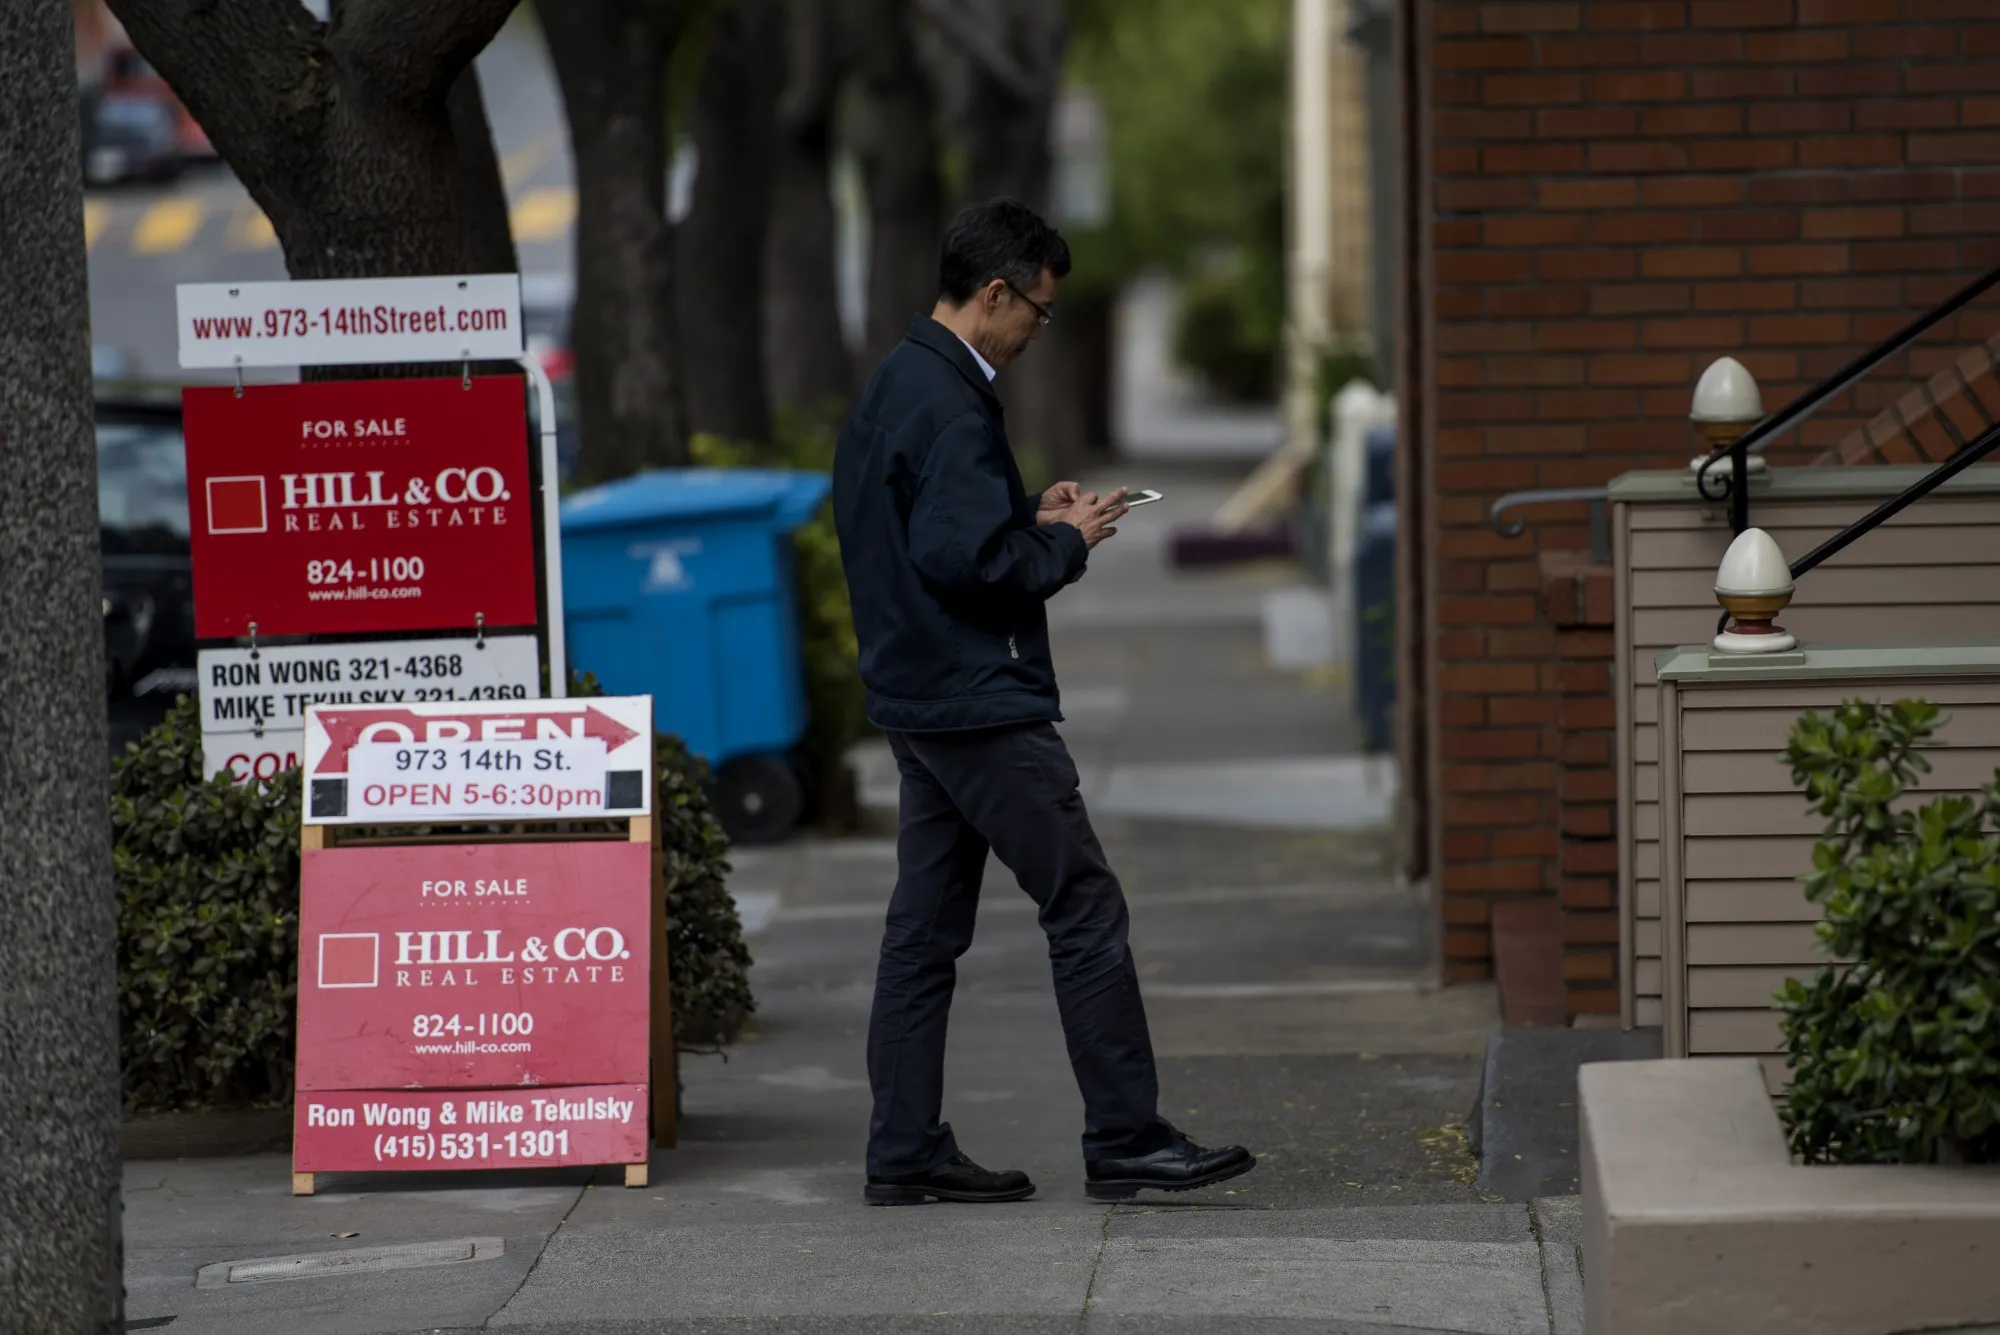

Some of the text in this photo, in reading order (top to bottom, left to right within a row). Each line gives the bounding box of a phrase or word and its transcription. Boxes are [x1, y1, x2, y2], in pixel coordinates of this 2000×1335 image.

[192, 304, 508, 340] www.973-14thStreet.com
[302, 417, 407, 439] FOR SALE
[281, 466, 511, 508] HILL & CO.
[285, 506, 508, 533] REAL ESTATE
[306, 556, 425, 585] 824-1100
[308, 586, 422, 601] www.hill-co.com
[212, 654, 463, 687] RON WONG 321-4368
[213, 695, 275, 720] MIKE
[395, 748, 572, 770] 973 14th St.
[363, 781, 601, 811] OPEN 5-6:30pm
[422, 878, 529, 897] FOR SALE
[394, 926, 630, 965] HILL & CO.
[396, 965, 625, 987] REAL ESTATE
[412, 1012, 534, 1037] 824-1100
[415, 1038, 532, 1055] www.hill-co.com
[308, 1097, 634, 1131] Ron Wong & Mike Tekulsky
[374, 1129, 569, 1161] (415) 531-1301
